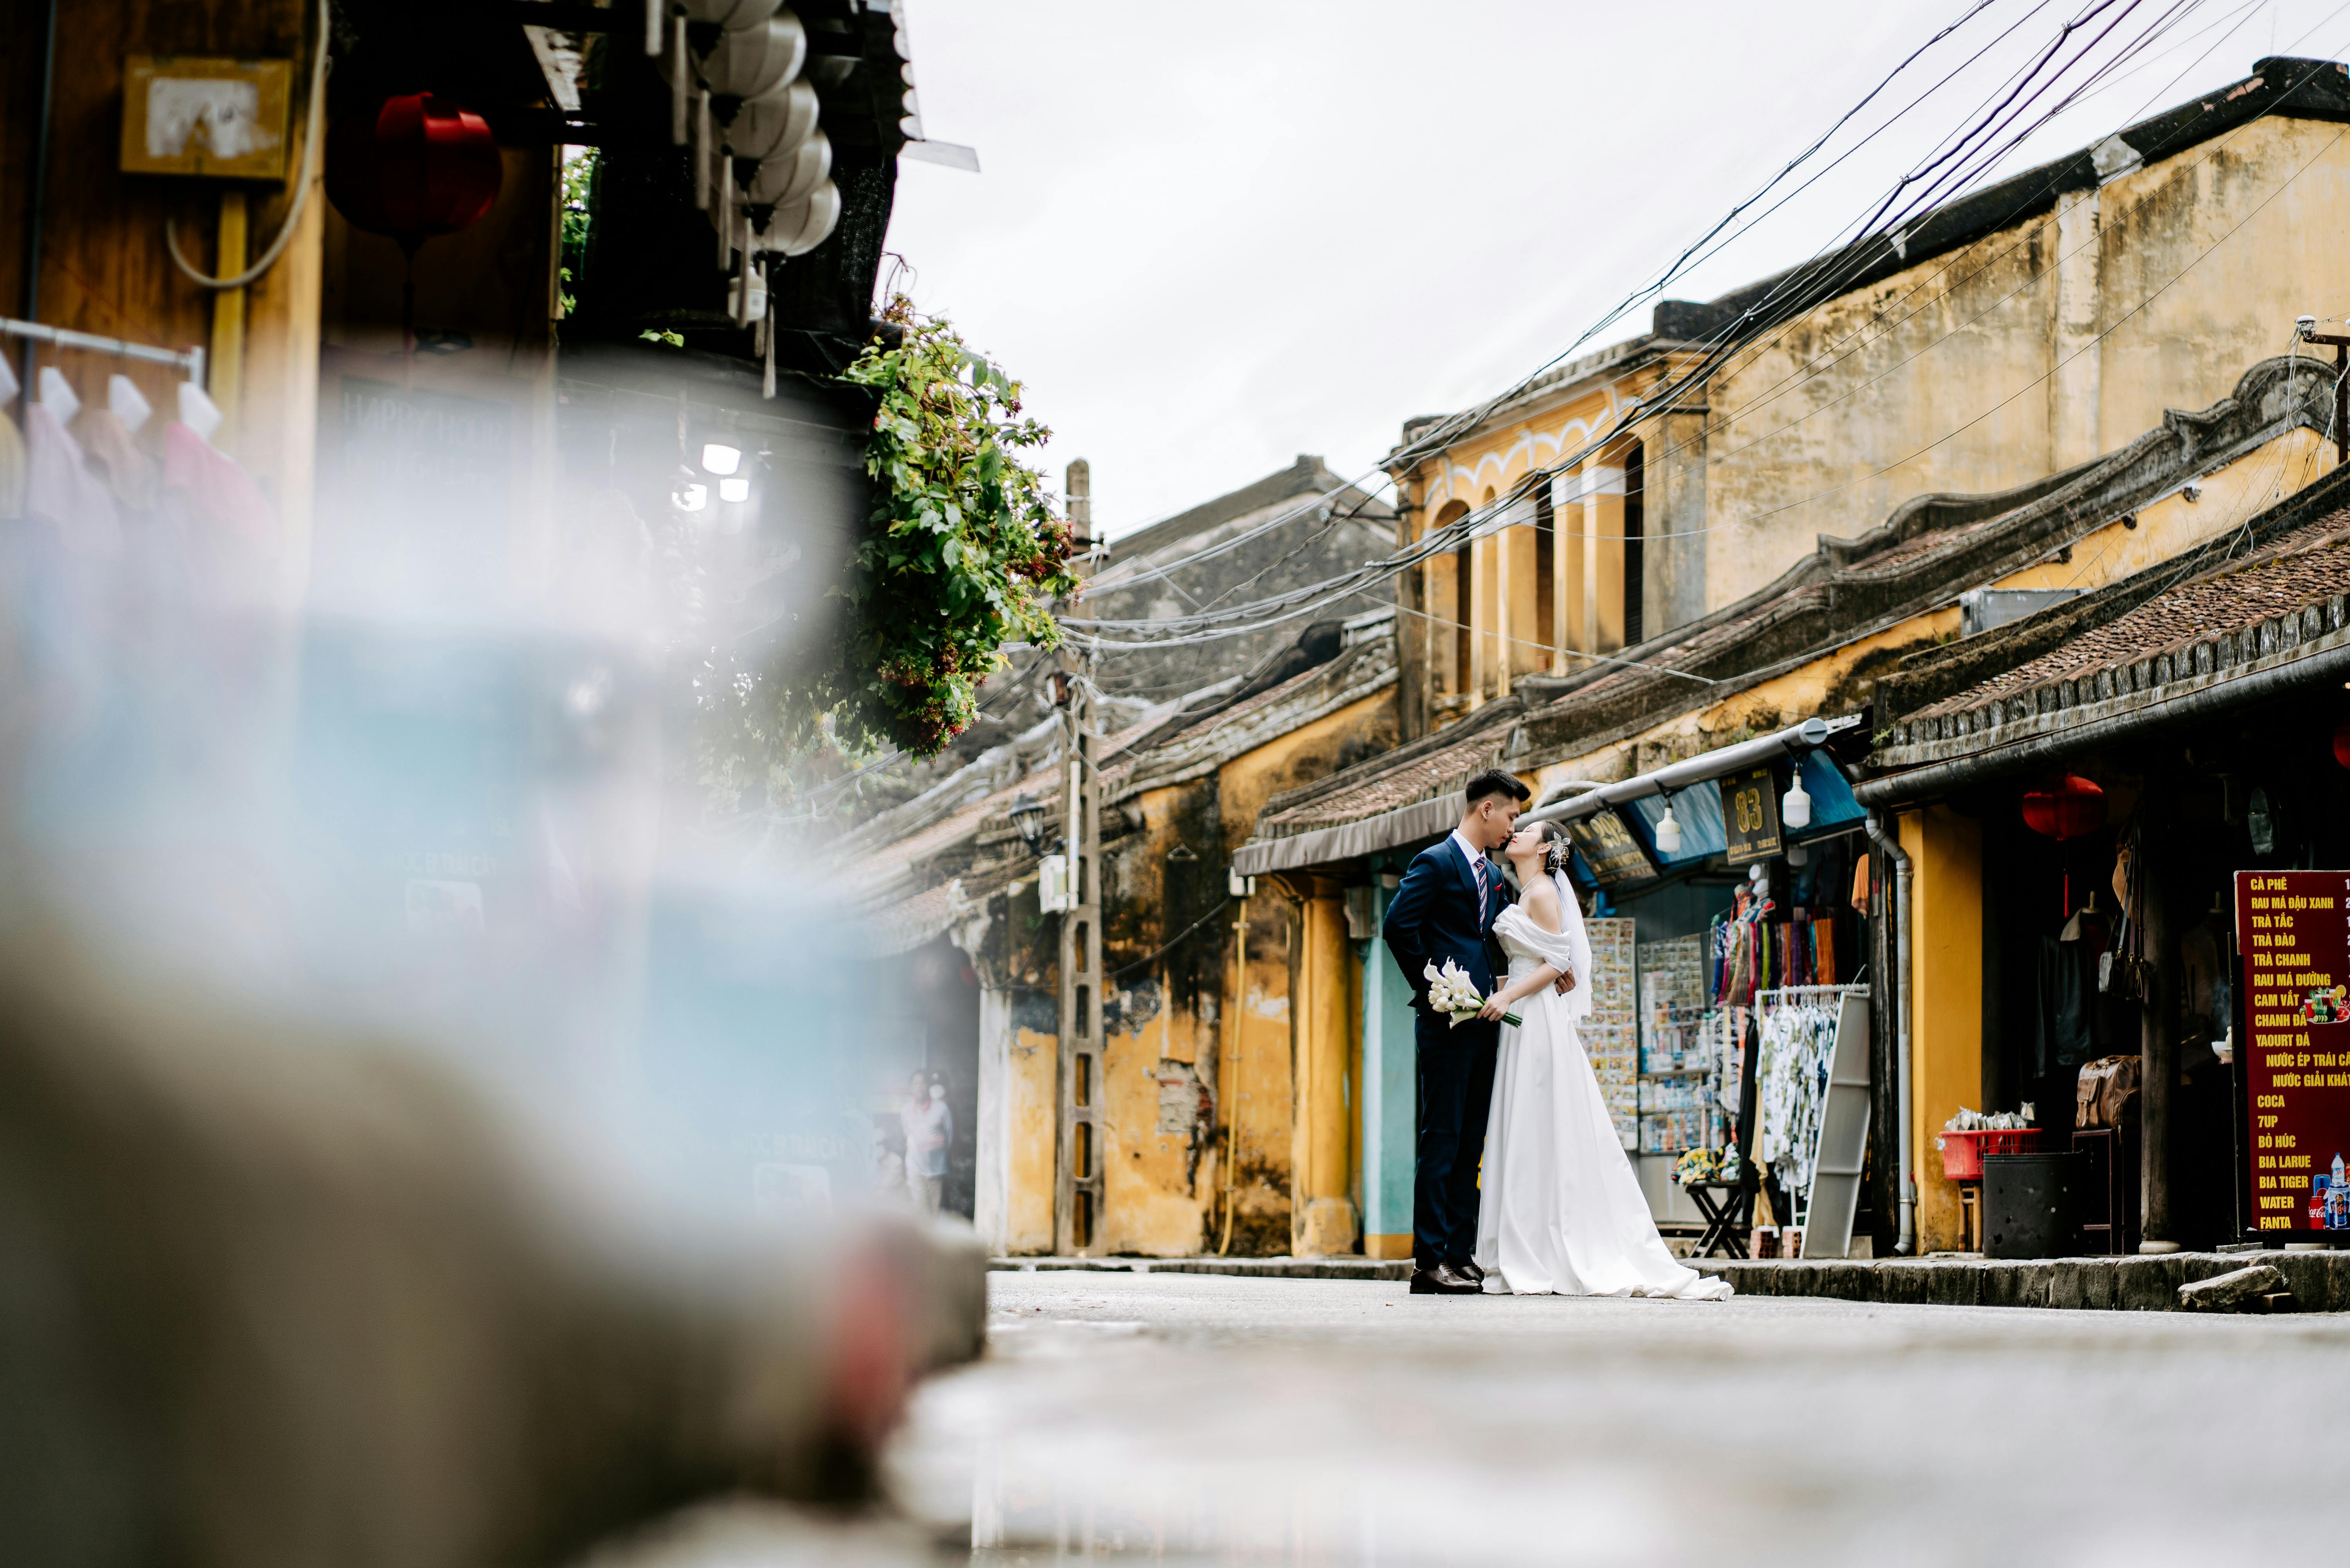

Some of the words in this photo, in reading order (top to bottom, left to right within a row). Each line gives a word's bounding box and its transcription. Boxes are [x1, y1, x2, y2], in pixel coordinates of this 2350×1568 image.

[1735, 788, 1762, 834] 83
[1589, 814, 1632, 849] 292
[2251, 876, 2265, 890] CÀ
[2267, 876, 2287, 890] PHÊ
[2251, 897, 2269, 909] RAU
[2271, 895, 2287, 909] MÁ
[2288, 895, 2307, 911] ĐẬU
[2309, 897, 2334, 909] XANH
[2252, 914, 2272, 928] TRÀ
[2274, 912, 2294, 928] TẮC
[2252, 932, 2272, 946] TRÀ
[2274, 932, 2296, 946] ĐÀO
[2253, 951, 2273, 966] TRÀ
[2275, 953, 2310, 966] CHANH
[2254, 974, 2274, 986] RAU
[2276, 971, 2294, 986] MÁ
[2296, 971, 2331, 986] ĐƯỜNG
[2254, 994, 2278, 1007] CAM
[2280, 989, 2299, 1006] VẮT
[2255, 1014, 2290, 1027] CHANH
[2292, 1011, 2307, 1026] ĐÁ
[2255, 1034, 2293, 1047] YAOURT
[2296, 1031, 2310, 1046] ĐÁ
[2266, 1052, 2294, 1067] NƯỚC
[2297, 1052, 2310, 1067] ÉP
[2313, 1051, 2336, 1066] TRÁI
[2273, 1072, 2301, 1087] NƯỚC
[2304, 1070, 2325, 1087] GIẢI
[2257, 1095, 2285, 1108] COCA
[2258, 1115, 2278, 1128] 7UP
[2258, 1132, 2272, 1148] BÒ
[2275, 1133, 2296, 1148] HÚC
[2259, 1156, 2277, 1168] BIA
[2279, 1155, 2311, 1168] LARUE
[2259, 1176, 2277, 1188] BIA
[2279, 1176, 2308, 1188] TIGER
[2260, 1196, 2294, 1209] WATER
[2260, 1216, 2292, 1229] FANTA
